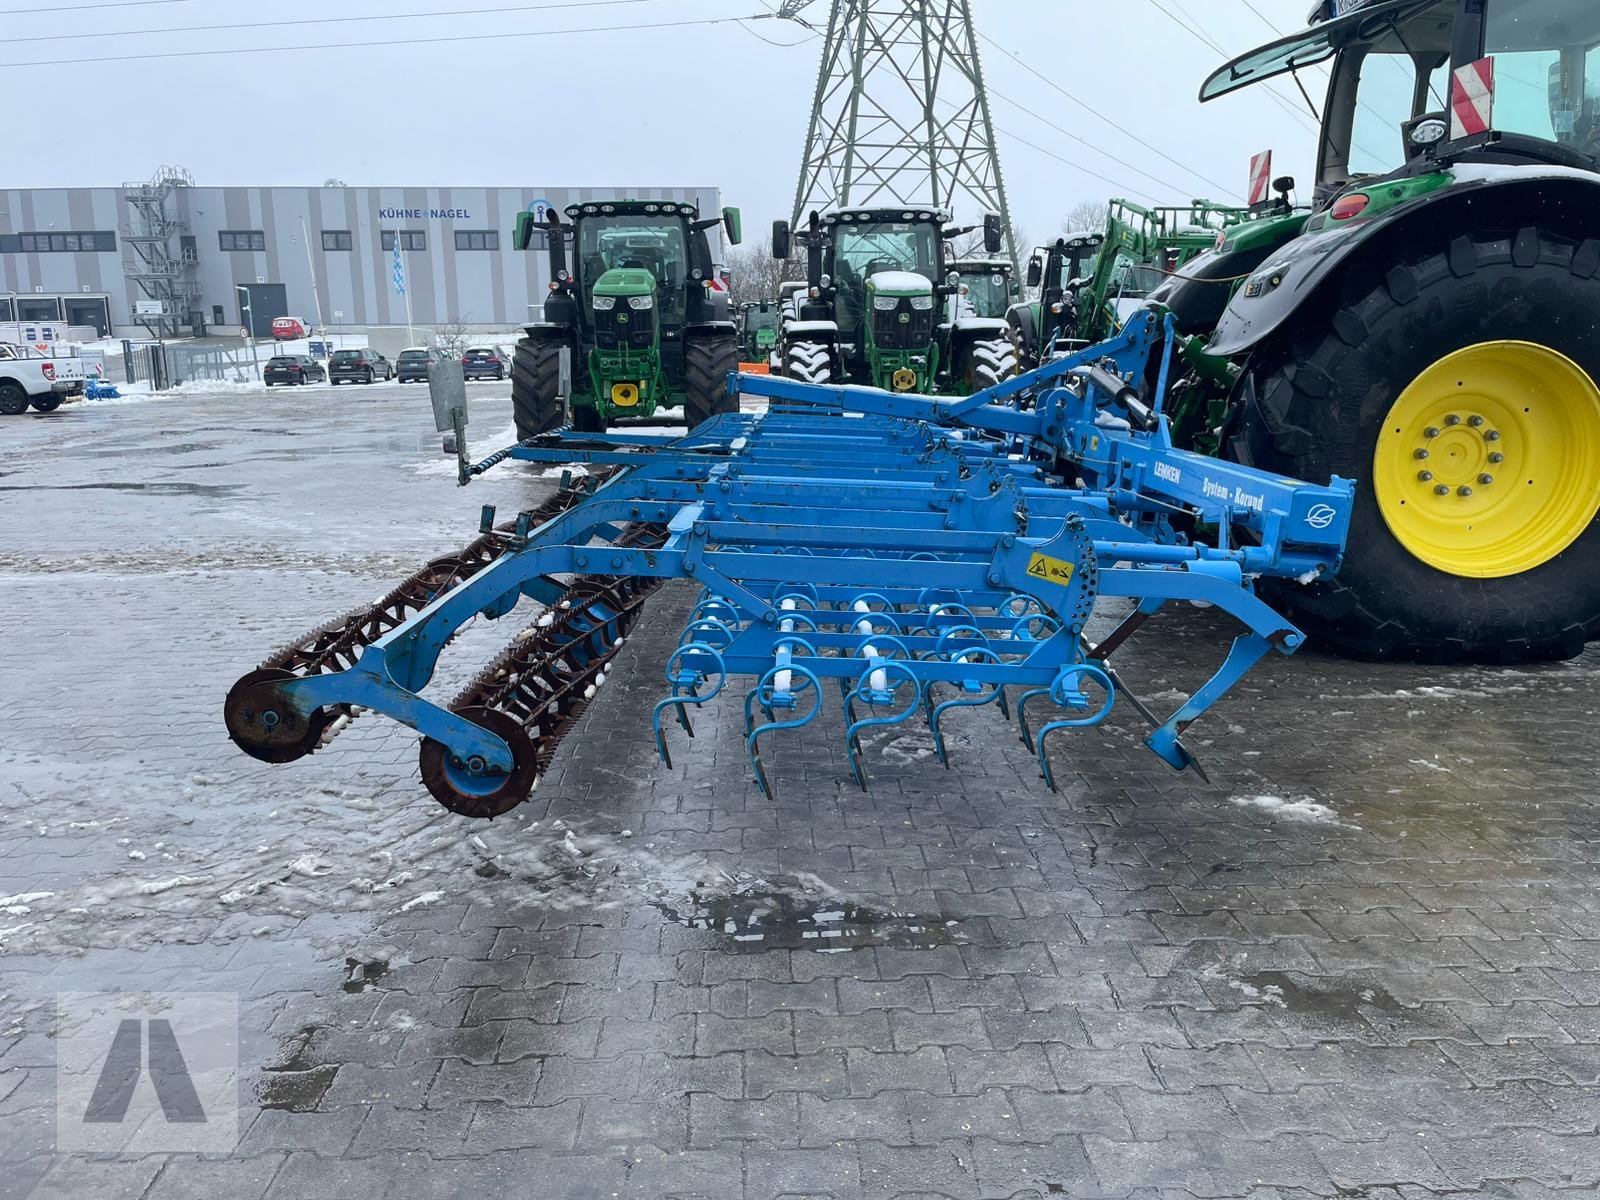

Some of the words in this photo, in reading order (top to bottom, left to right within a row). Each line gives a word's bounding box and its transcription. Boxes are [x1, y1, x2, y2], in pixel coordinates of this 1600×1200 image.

[1154, 461, 1181, 484] LEMKEN
[1203, 477, 1228, 499] System
[1234, 487, 1264, 511] Korund
